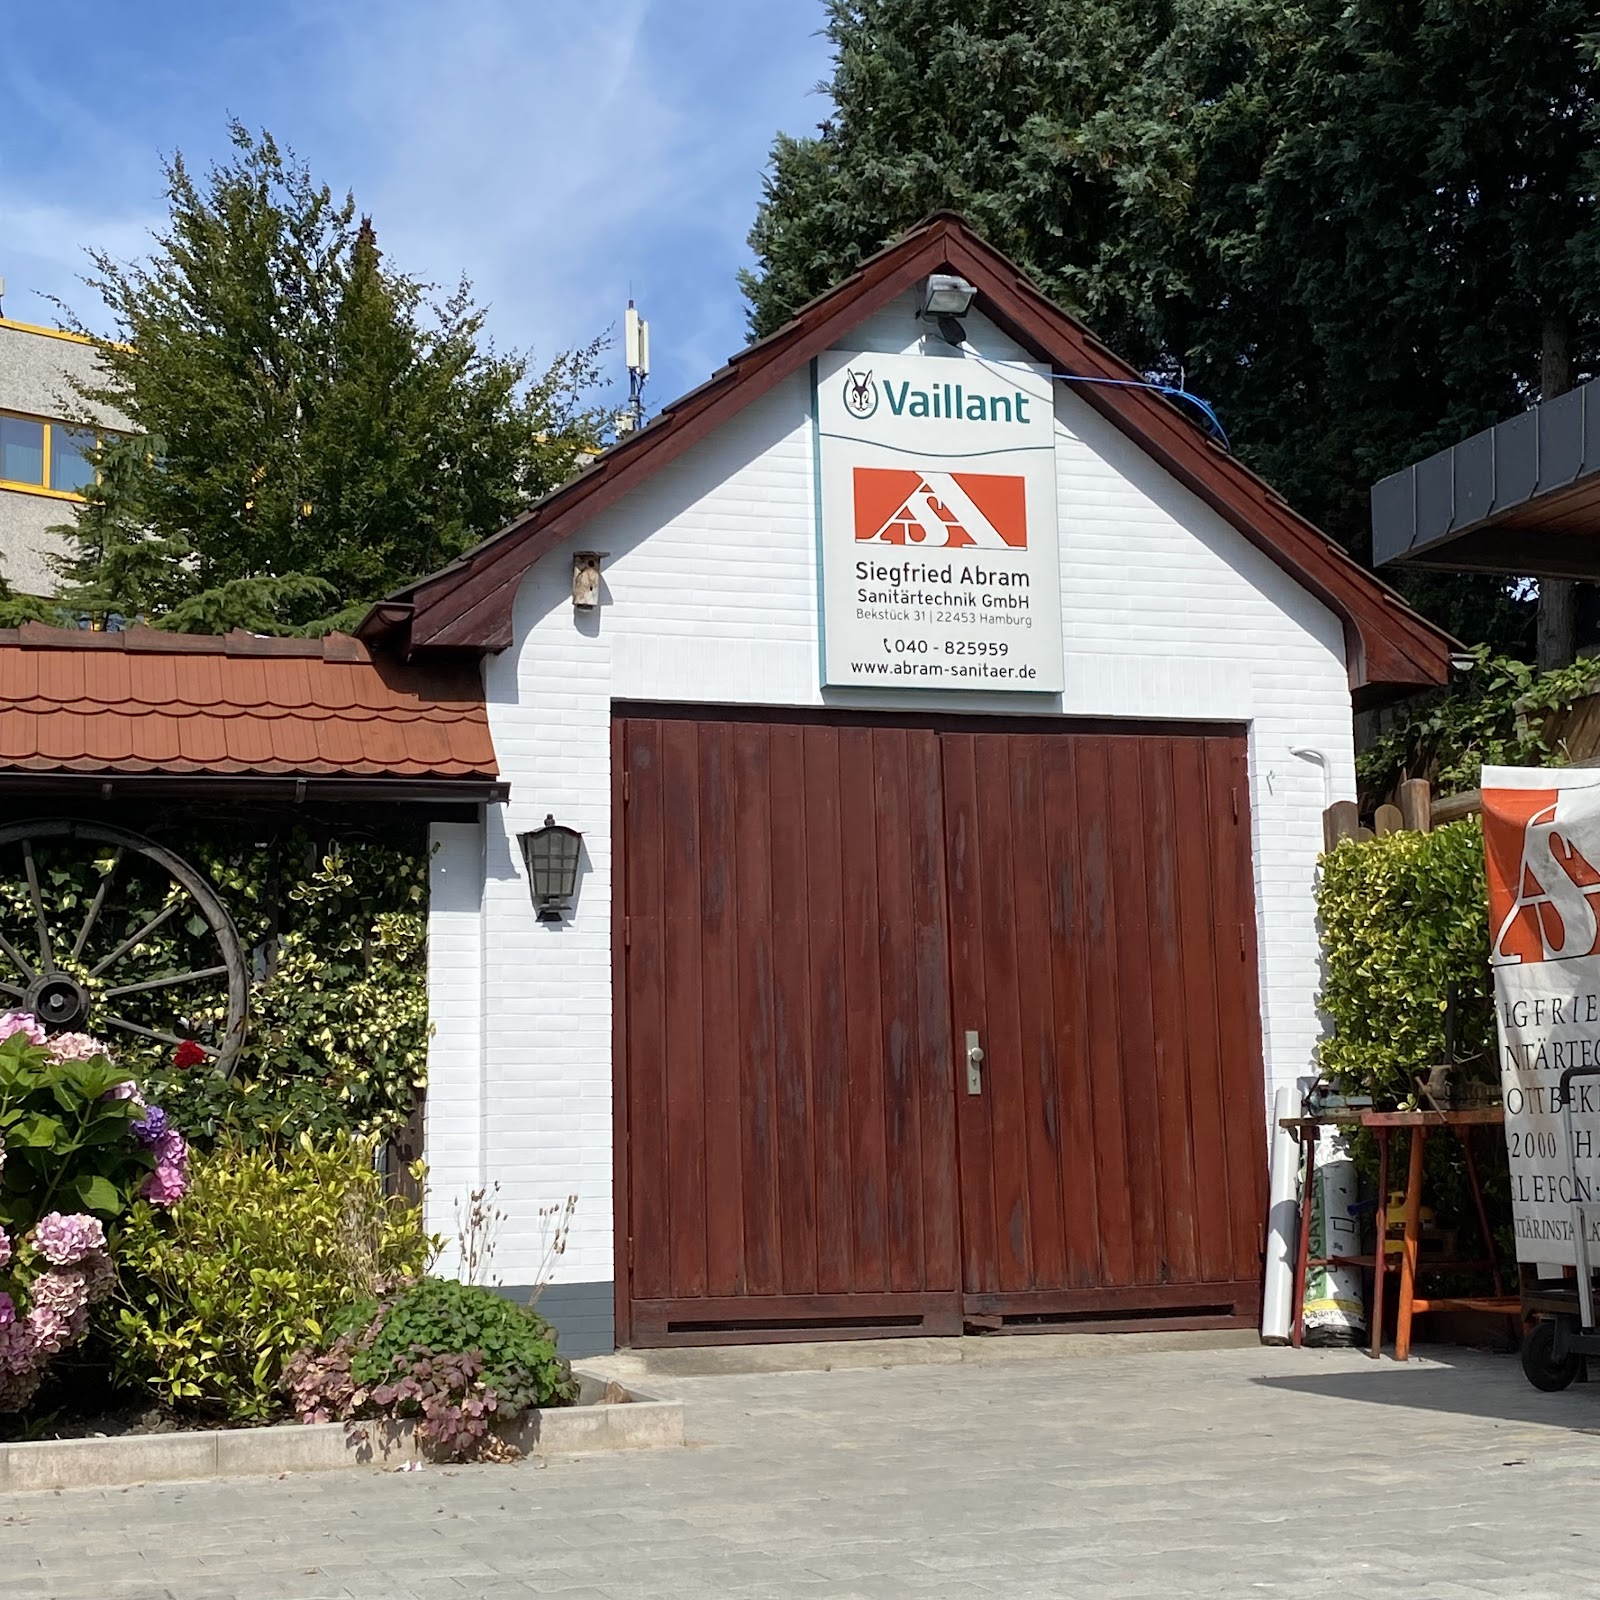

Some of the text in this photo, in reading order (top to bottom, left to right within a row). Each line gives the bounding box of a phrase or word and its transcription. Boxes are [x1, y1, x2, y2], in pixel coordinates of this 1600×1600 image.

[882, 380, 1031, 424] Vaillant
[855, 561, 1030, 587] Siegfried Abram
[857, 588, 1030, 609] Sanitärtechnik GmbH
[856, 608, 910, 621] Bekstück
[913, 610, 926, 622] 31
[936, 612, 976, 624] 22453
[980, 613, 1033, 629] Hamburg
[894, 639, 928, 654] 040
[944, 641, 1009, 656] 825959
[850, 660, 1037, 680] www.abram-sanitaer.de
[1507, 1084, 1600, 1115] OTTBEK
